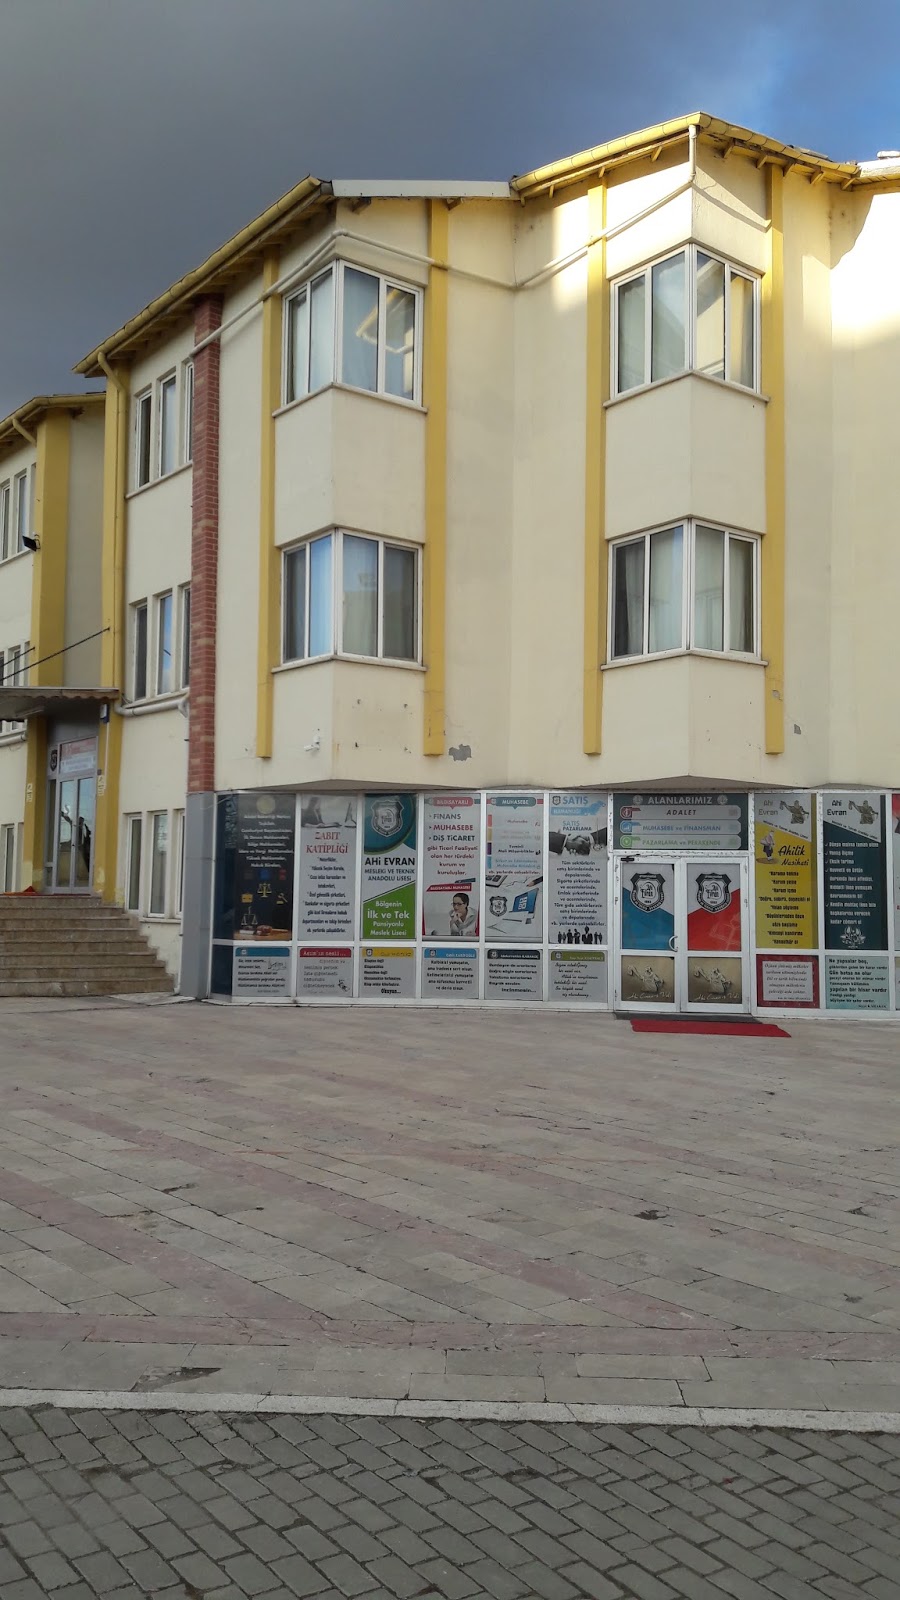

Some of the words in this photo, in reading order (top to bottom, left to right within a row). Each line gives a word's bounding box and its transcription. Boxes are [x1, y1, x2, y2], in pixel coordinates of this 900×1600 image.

[562, 796, 588, 806] SATIŞ
[647, 796, 713, 804] ALANLARIMIZ
[758, 808, 778, 816] Evran
[314, 832, 340, 840] ZABIT
[306, 843, 348, 854] KATİPLİĞİ
[778, 845, 805, 856] Ahilik
[384, 858, 416, 866] EVRAN
[781, 858, 809, 866] Nasihati
[376, 900, 402, 909] Bölgenin
[367, 908, 379, 919] İlk
[394, 910, 410, 919] Tek
[373, 920, 404, 928] Pansiyonlu
